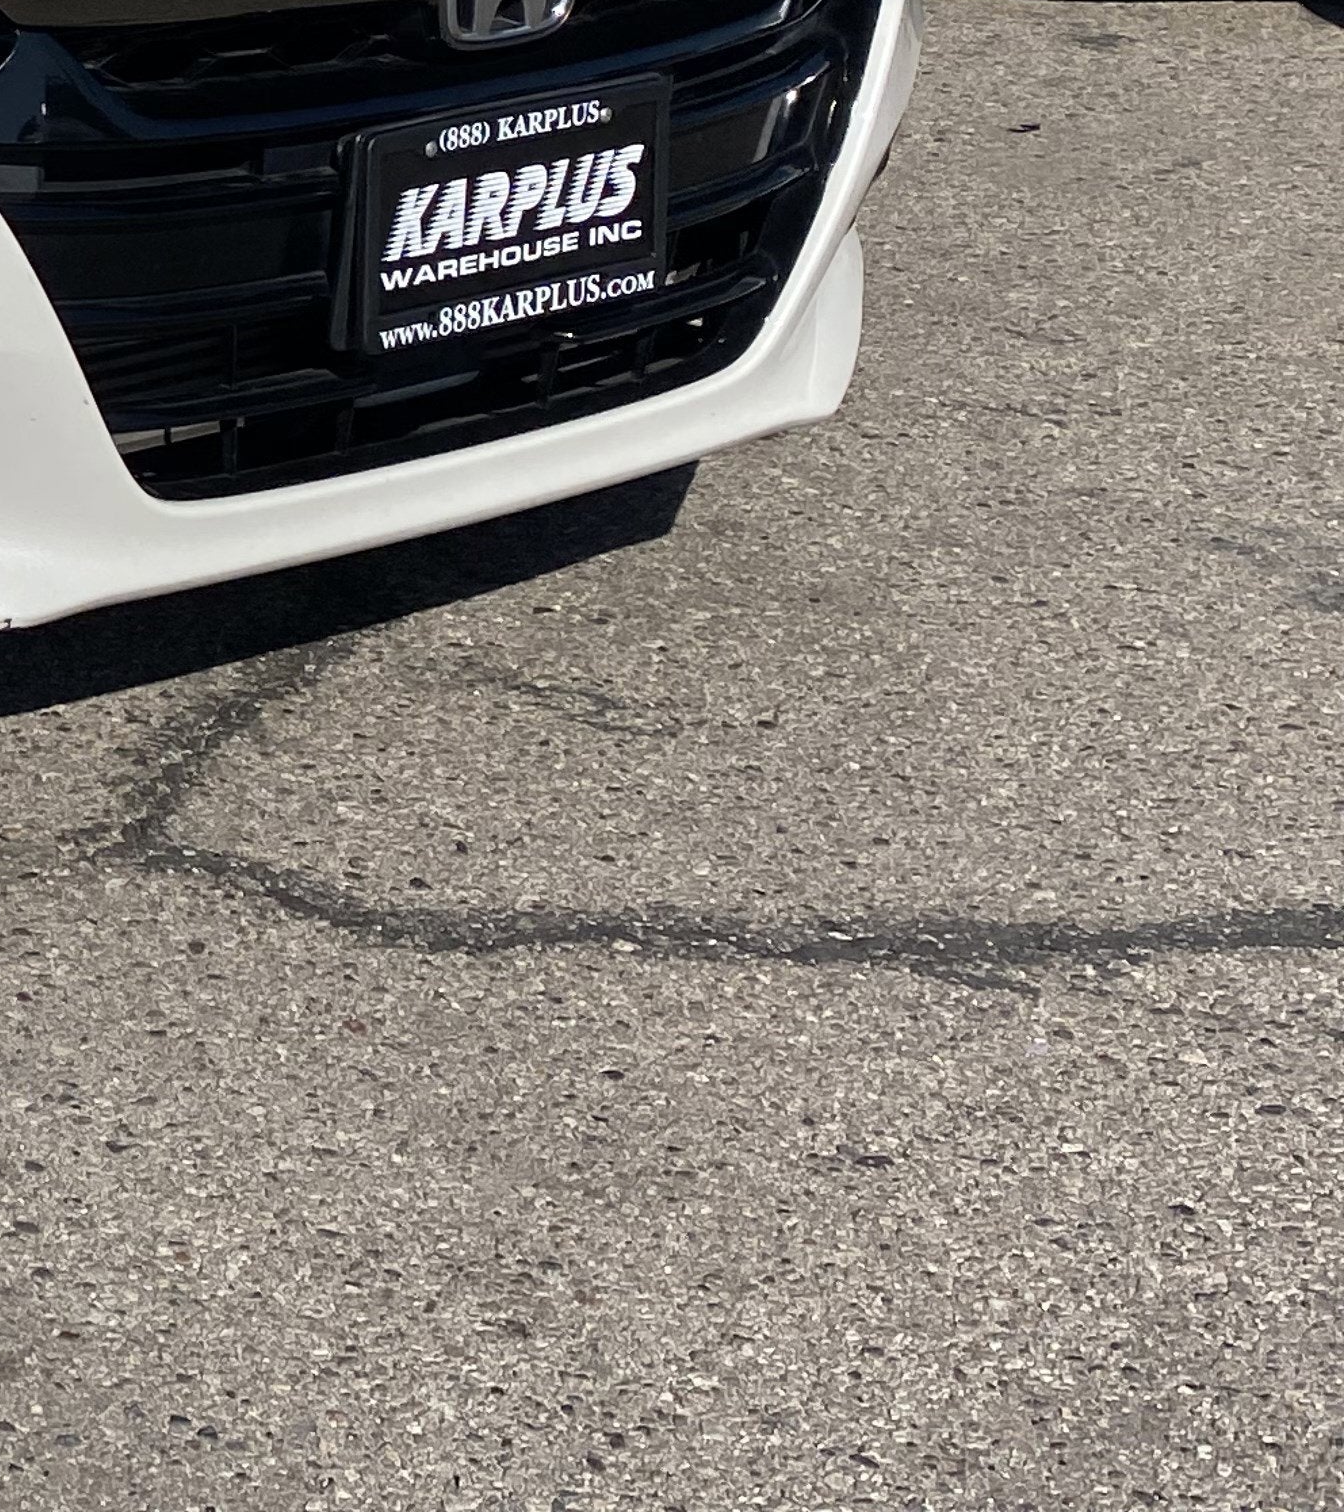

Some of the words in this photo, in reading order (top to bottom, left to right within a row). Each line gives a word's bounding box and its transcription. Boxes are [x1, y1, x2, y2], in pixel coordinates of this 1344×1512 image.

[439, 121, 491, 153] (888)
[496, 99, 600, 142] KARPLUS
[381, 143, 645, 263] KARPLUS
[380, 231, 580, 291] WAREHOUSE
[589, 219, 643, 247] INC
